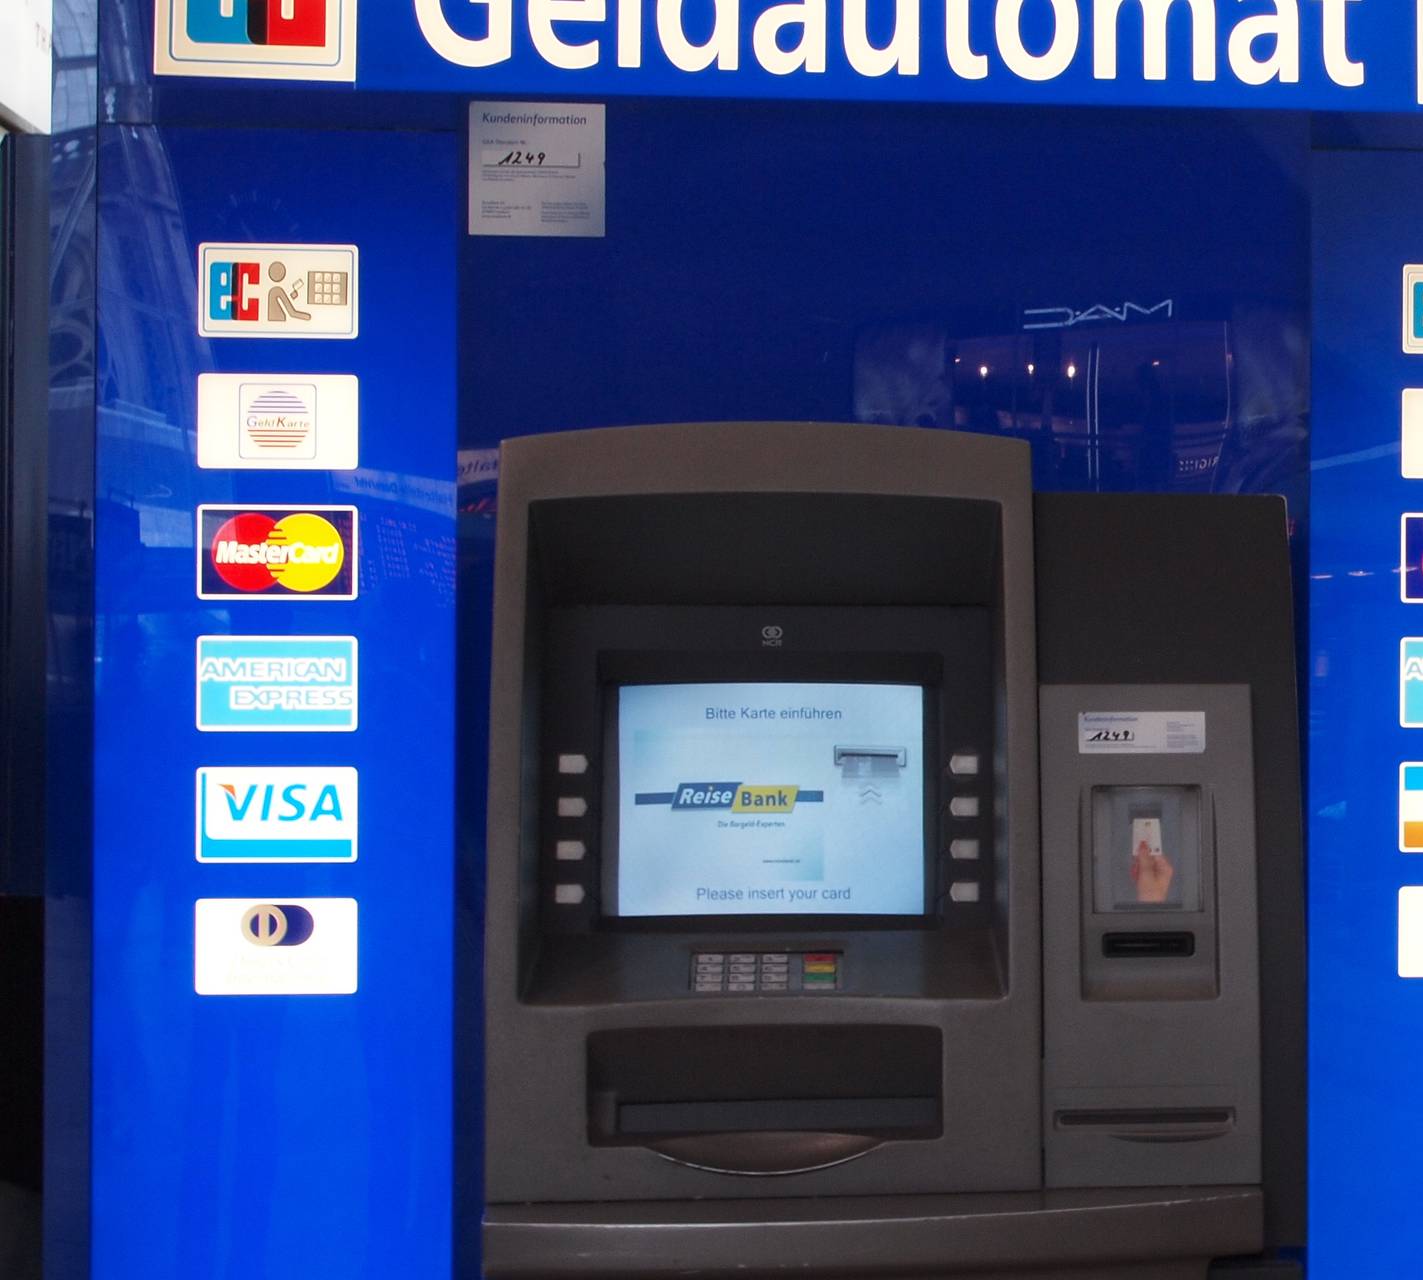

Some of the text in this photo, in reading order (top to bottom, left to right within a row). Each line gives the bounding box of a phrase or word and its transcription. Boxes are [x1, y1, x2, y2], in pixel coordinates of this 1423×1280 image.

[482, 112, 587, 127] Kundeninformation
[498, 151, 547, 166] 1249
[246, 415, 310, 428] GeldKarte
[215, 540, 340, 564] MasterCard
[201, 660, 345, 679] AMERICAN
[233, 688, 353, 707] EXPRESS
[705, 707, 842, 720] Bitte Karte einführen
[217, 783, 343, 822] VISA
[679, 786, 788, 807] Reise Bank
[696, 887, 851, 903] Please insert your card
